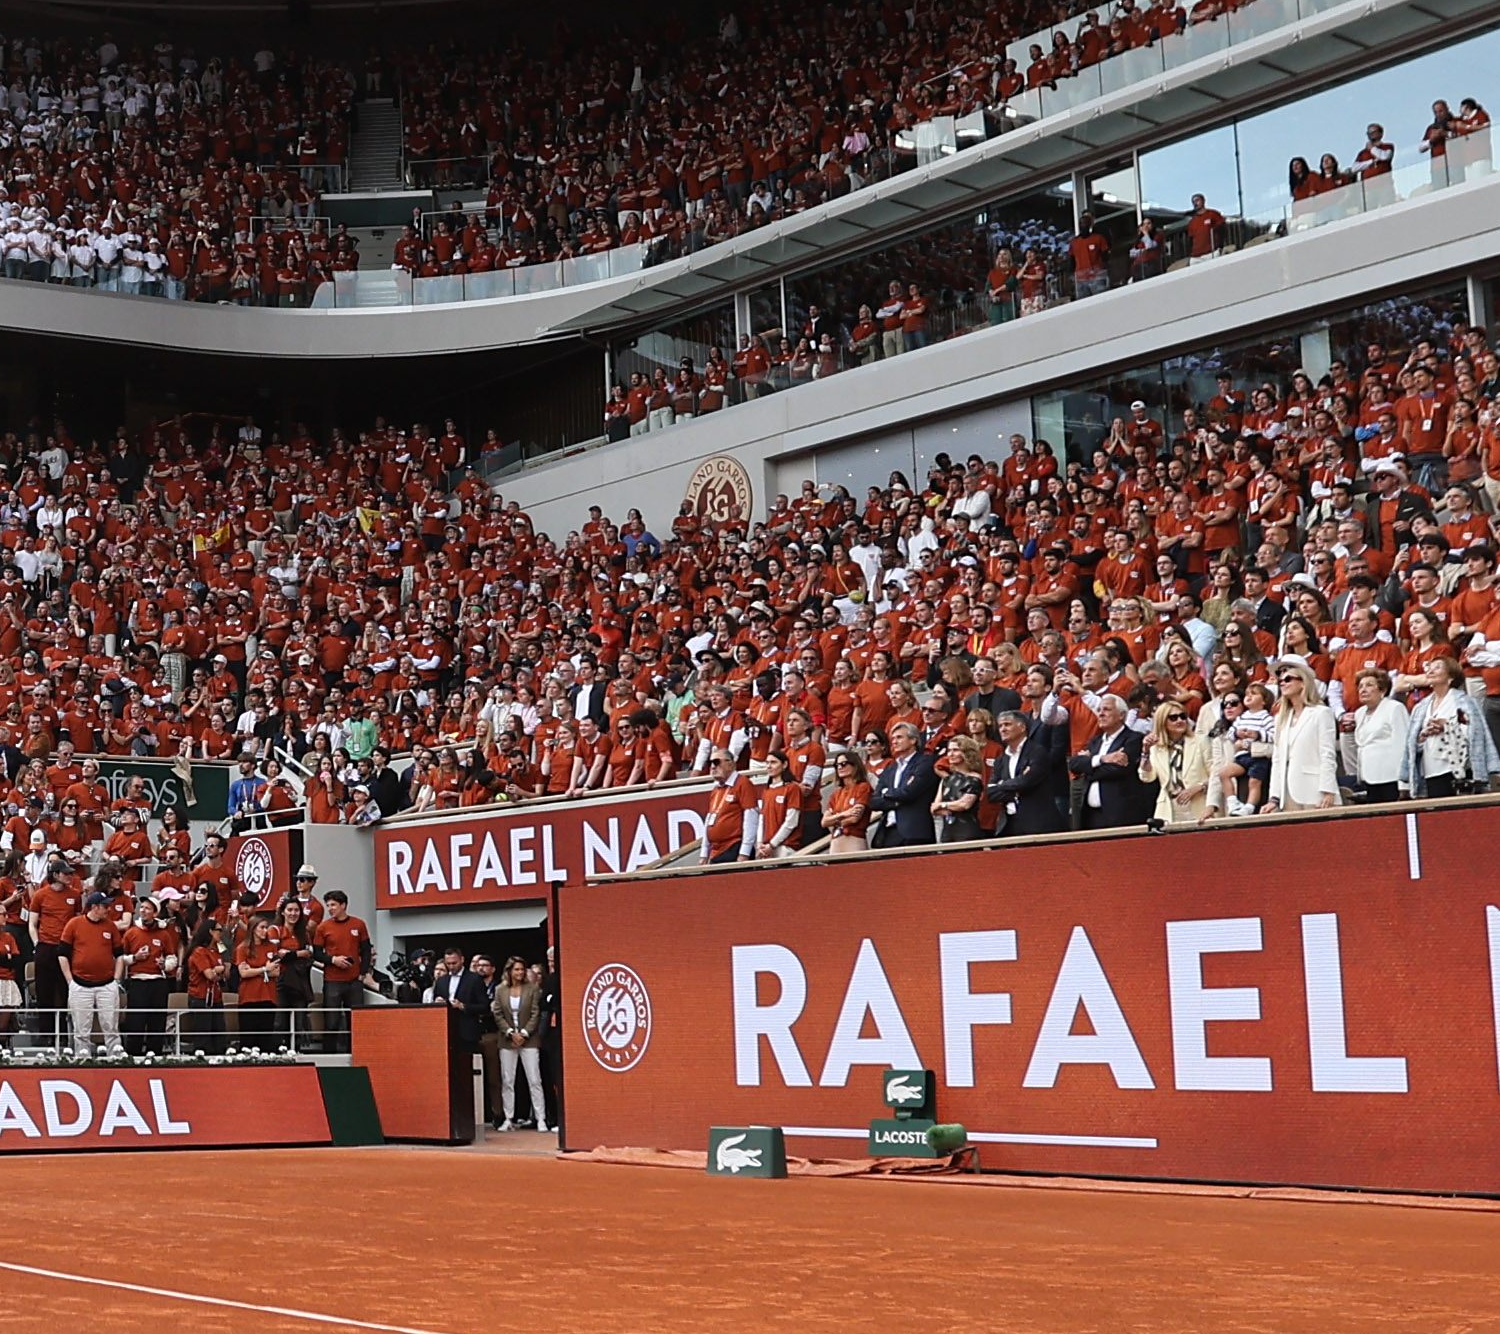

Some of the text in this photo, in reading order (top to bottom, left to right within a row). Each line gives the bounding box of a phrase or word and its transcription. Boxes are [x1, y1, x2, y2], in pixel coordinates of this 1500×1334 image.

[716, 460, 748, 509] GARROS
[388, 824, 568, 895] RAFAEL
[586, 971, 647, 1029] ROLAND GARROS
[730, 912, 1409, 1092] RAFAEL
